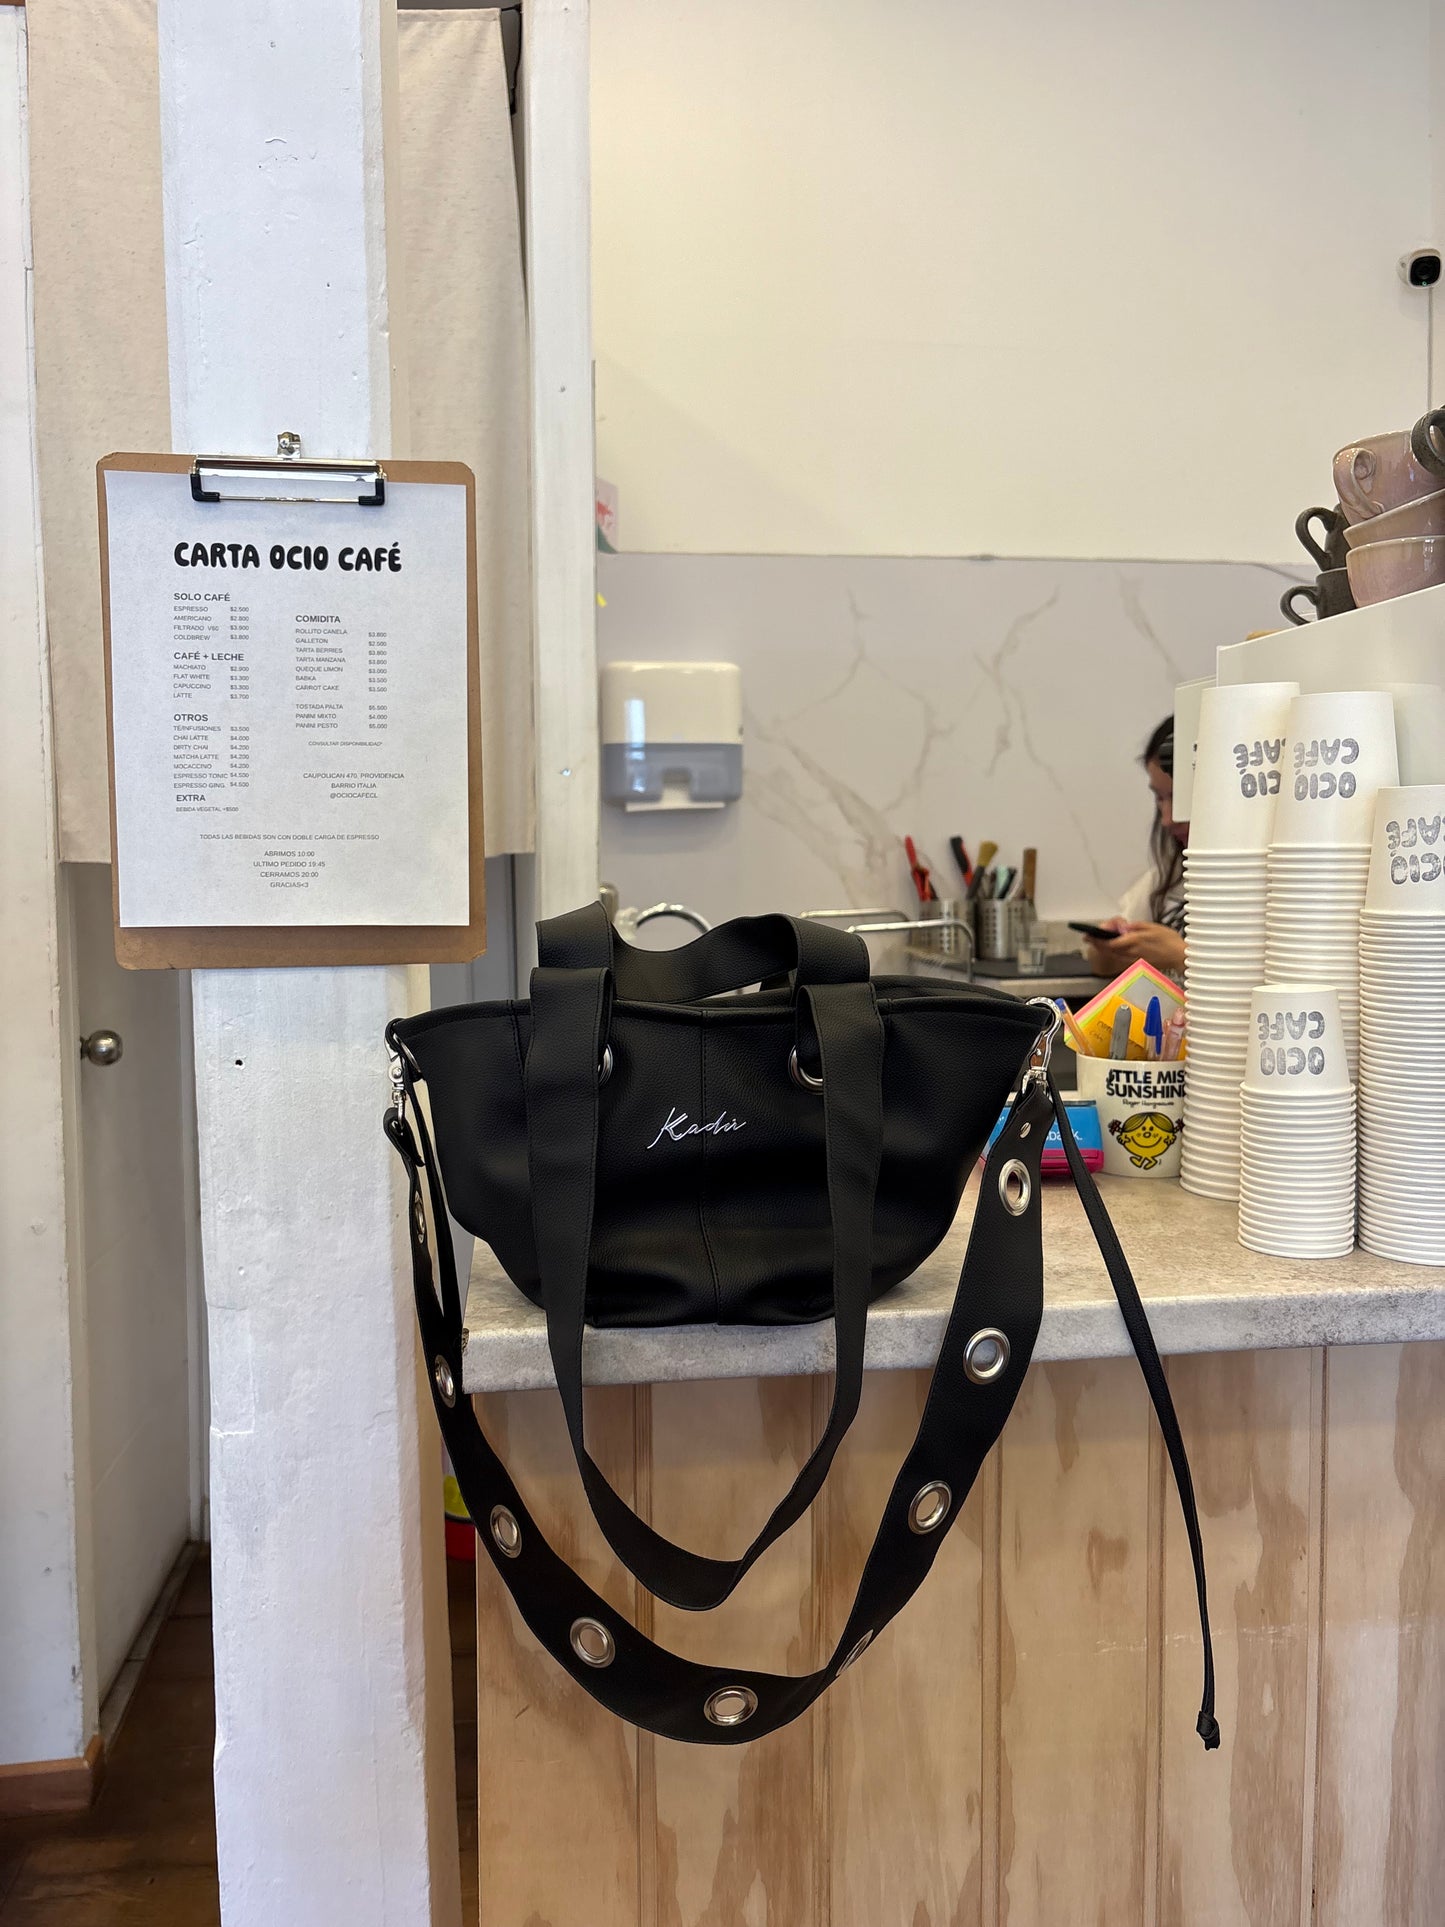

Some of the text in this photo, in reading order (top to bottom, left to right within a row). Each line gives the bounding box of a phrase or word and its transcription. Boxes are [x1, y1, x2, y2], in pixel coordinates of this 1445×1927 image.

[174, 541, 402, 573] CARTA OCIO CAFÉ
[173, 592, 231, 601] SOLO CAFÉ
[295, 615, 341, 624] COMIDITA
[173, 651, 201, 660] CAFÉ
[211, 653, 245, 661] LECHE
[173, 713, 209, 722] OTROS
[1293, 738, 1360, 776] CAFÉ
[176, 794, 206, 802] EXTRA
[1240, 770, 1282, 799] CIO
[1294, 771, 1357, 801] OCIO
[1386, 815, 1445, 857] AFÉ
[1390, 852, 1445, 885] CIO
[1257, 1011, 1326, 1048] CAFÉ
[1260, 1046, 1325, 1076] OCIO
[1157, 1069, 1187, 1084] MIS
